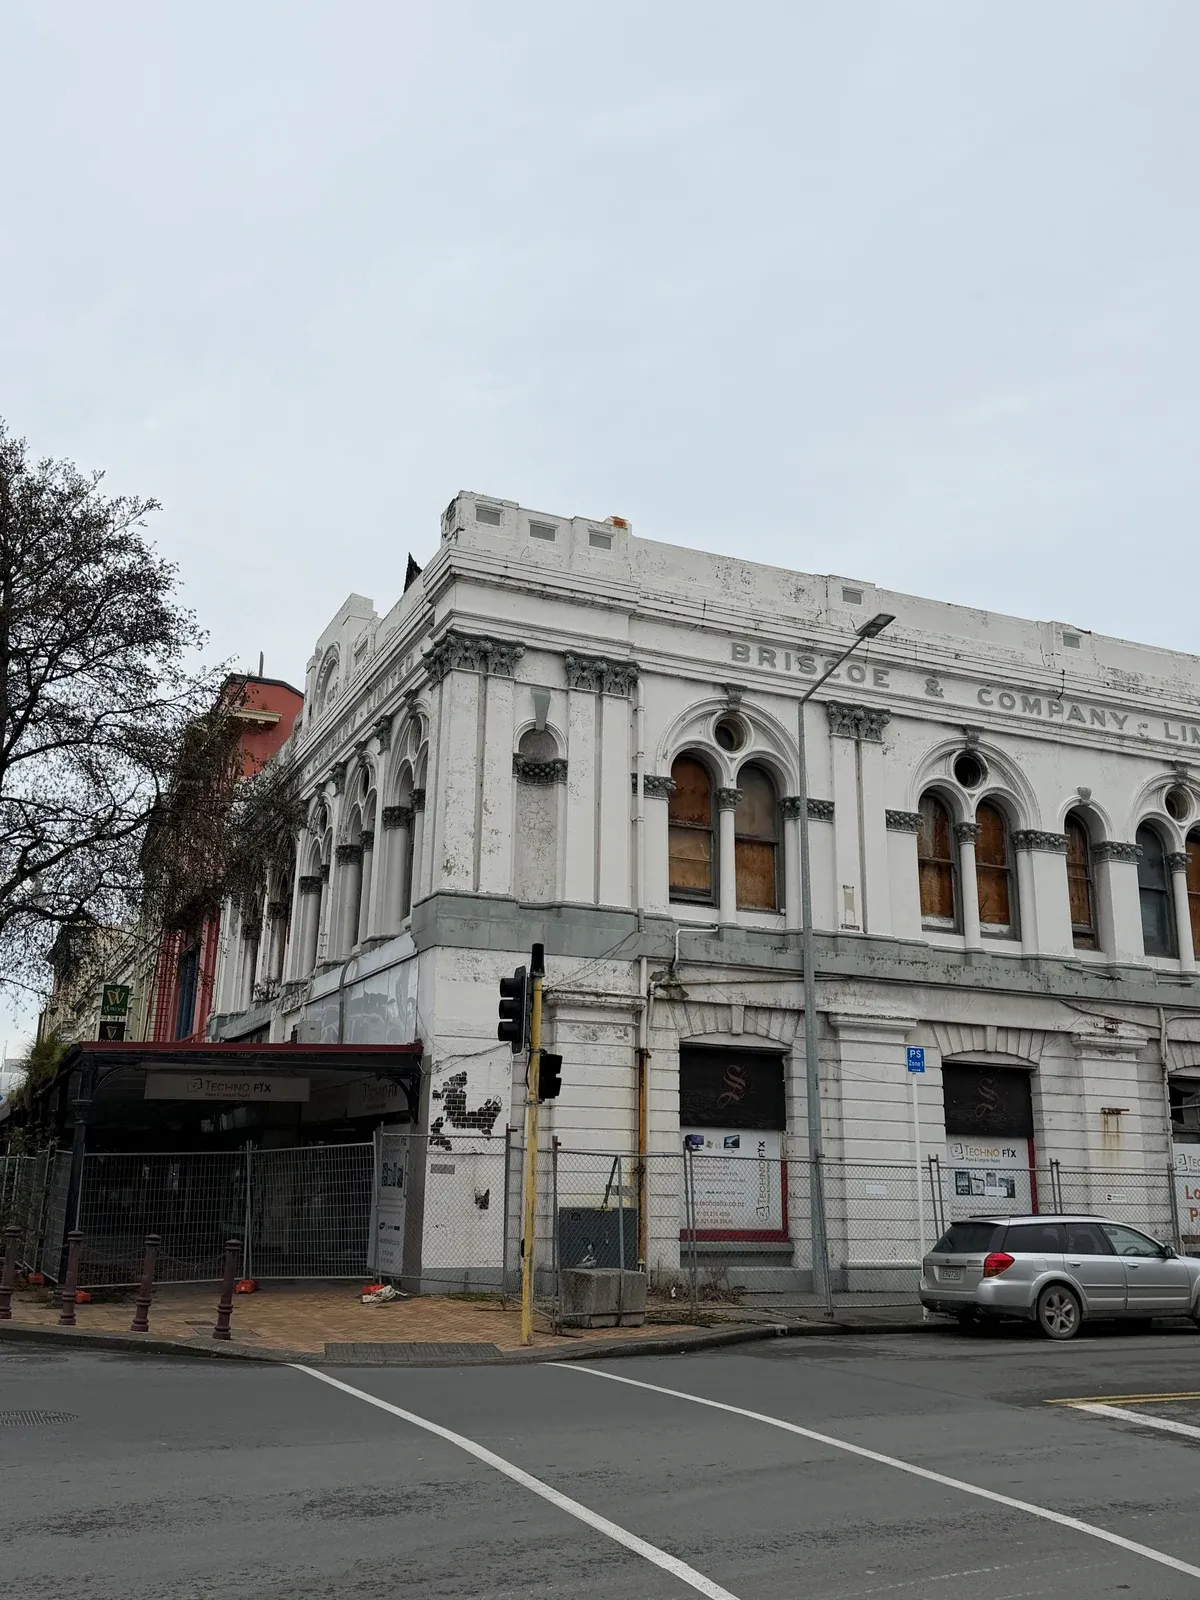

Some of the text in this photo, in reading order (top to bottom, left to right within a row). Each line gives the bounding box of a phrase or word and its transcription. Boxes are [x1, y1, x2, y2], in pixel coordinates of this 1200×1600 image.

[731, 642, 890, 689] BRISCOE
[924, 678, 945, 698] &
[977, 688, 1129, 730] COMPANY
[909, 1049, 922, 1058] PS
[908, 1059, 921, 1067] Zone
[205, 1079, 250, 1092] TECHNO
[964, 1144, 1000, 1157] TECHNO
[758, 1161, 766, 1205] TECHNO
